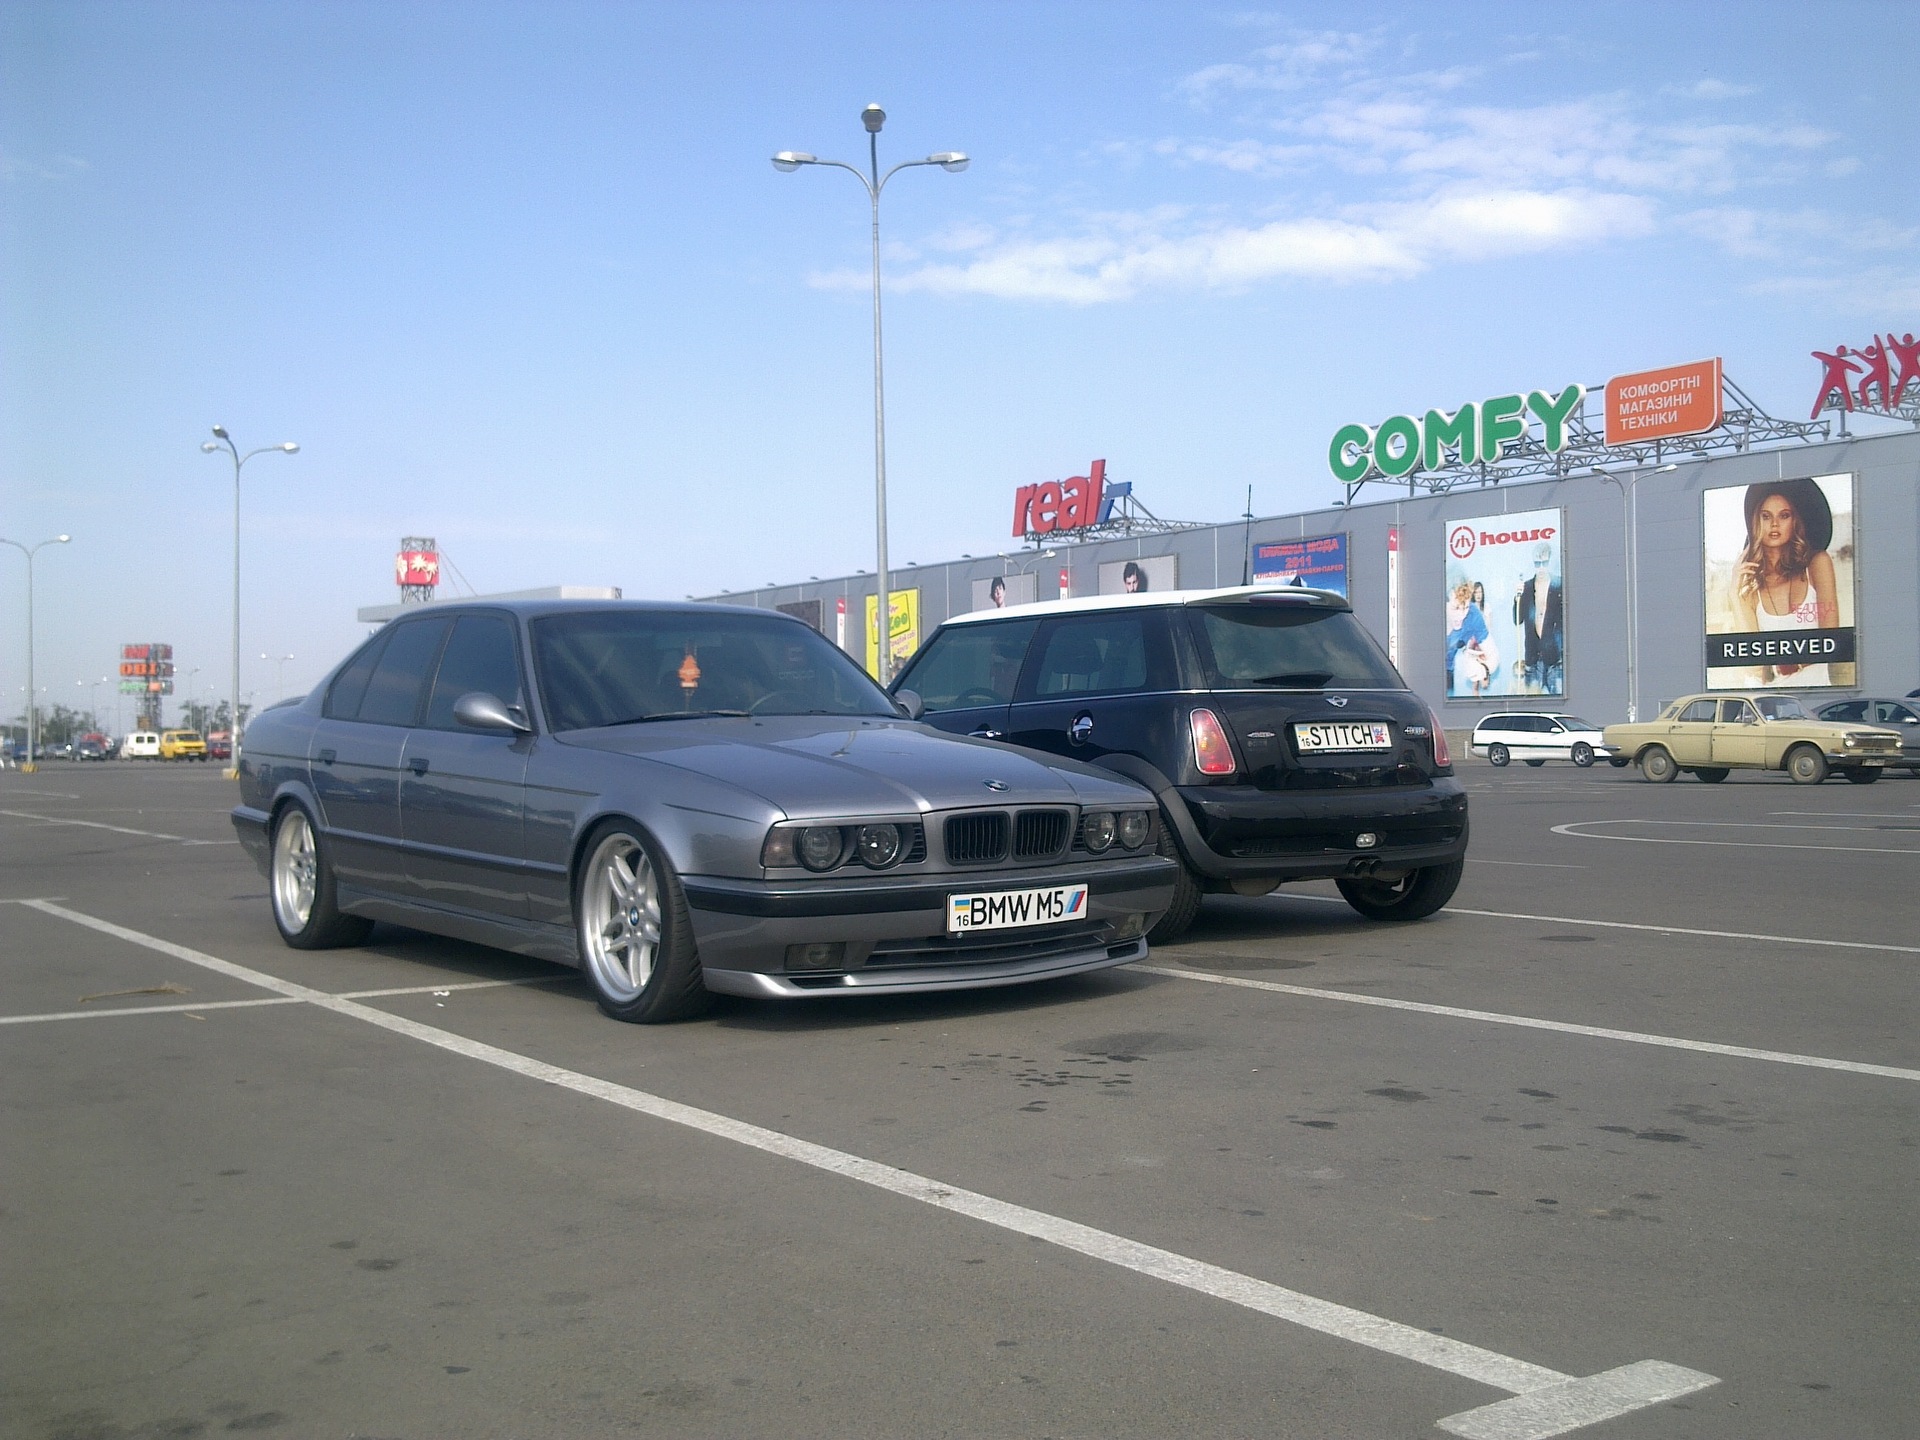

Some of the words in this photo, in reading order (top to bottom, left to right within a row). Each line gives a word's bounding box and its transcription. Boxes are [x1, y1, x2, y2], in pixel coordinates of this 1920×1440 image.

[1619, 375, 1700, 399] КОМФОРТНІ
[1619, 392, 1692, 415] МАГАЗИНИ
[1620, 411, 1678, 430] ТЕХНІКИ
[1328, 383, 1587, 484] COMFY
[1480, 528, 1556, 546] house
[1285, 555, 1312, 569] 2011
[1723, 638, 1836, 657] RESERVED
[1301, 737, 1311, 747] 16
[1310, 725, 1374, 746] STITCH
[956, 914, 969, 927] 16
[970, 893, 1032, 926] BMW
[1036, 890, 1064, 920] M5
